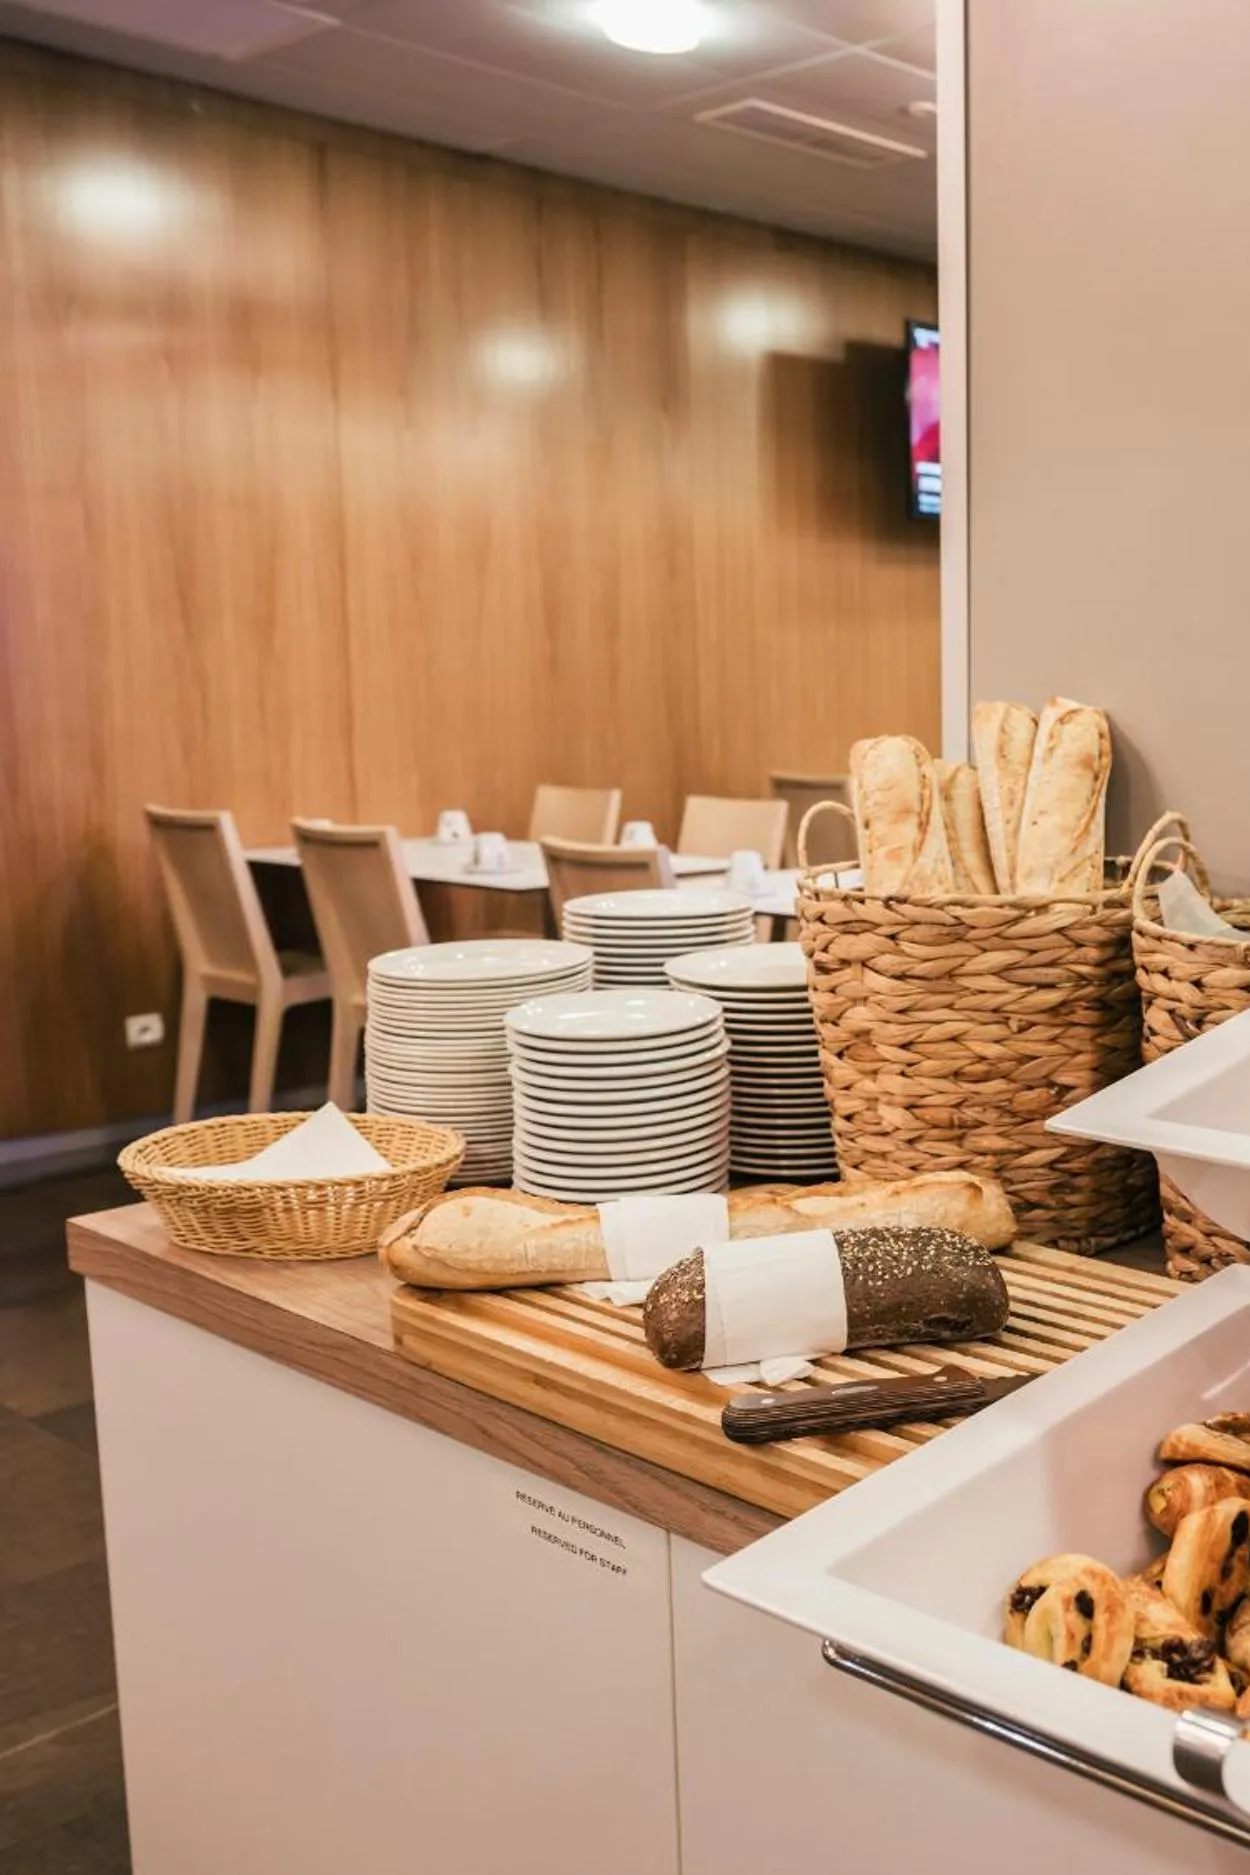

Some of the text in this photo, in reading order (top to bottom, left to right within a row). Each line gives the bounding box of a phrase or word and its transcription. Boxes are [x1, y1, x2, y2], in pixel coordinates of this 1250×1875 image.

[531, 1525, 628, 1575] RESERVED FOR STAFF
[571, 1516, 626, 1549] PERSONNEL
